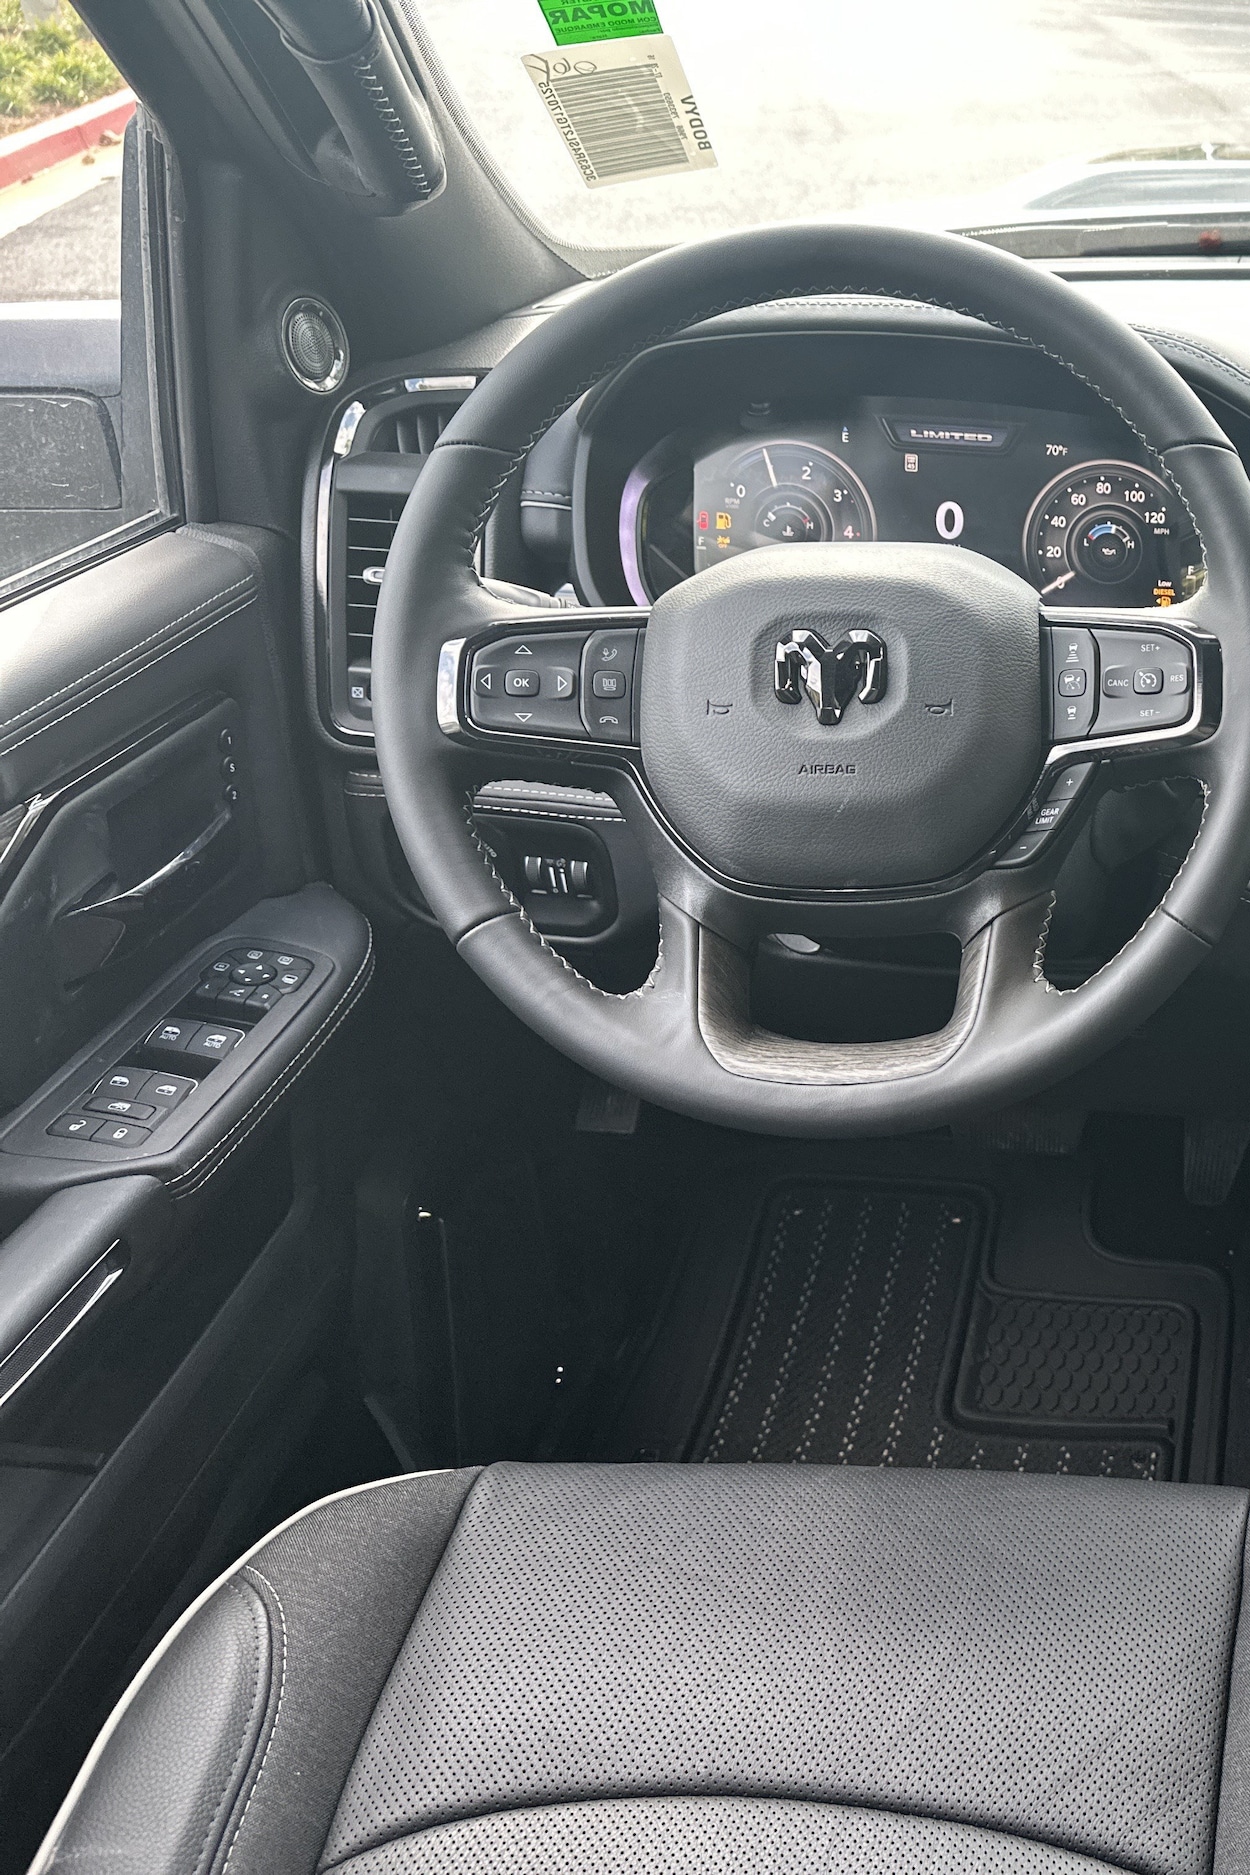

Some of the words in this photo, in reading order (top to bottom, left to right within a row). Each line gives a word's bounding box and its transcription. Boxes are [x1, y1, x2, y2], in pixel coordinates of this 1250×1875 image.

[842, 432, 849, 443] E
[910, 429, 993, 442] LIMITED
[1046, 444, 1068, 456] 70°F
[801, 466, 811, 480] 2
[736, 485, 746, 498] 0
[1096, 482, 1111, 494] 80
[724, 497, 740, 505] RPM
[833, 489, 842, 502] 3
[1071, 493, 1086, 506] 60
[1124, 490, 1145, 503] 100
[763, 519, 770, 527] C
[935, 500, 964, 540] 0
[1050, 515, 1066, 528] 40
[1144, 511, 1165, 524] 120
[843, 525, 854, 539] 4
[698, 536, 705, 546] F
[1083, 538, 1089, 546] L
[1127, 541, 1134, 549] H
[1046, 545, 1061, 558] 20
[1187, 565, 1195, 575] F
[1153, 588, 1175, 596] DIESEL
[513, 677, 530, 688] OK
[1107, 679, 1129, 688] CANC
[1170, 674, 1184, 683] RES
[227, 736, 232, 745] 1
[230, 763, 235, 773] S
[798, 764, 856, 775] AIRBAG
[1041, 808, 1060, 816] GEAR
[1035, 816, 1055, 825] LIMIT
[203, 1041, 221, 1049] AUTO
